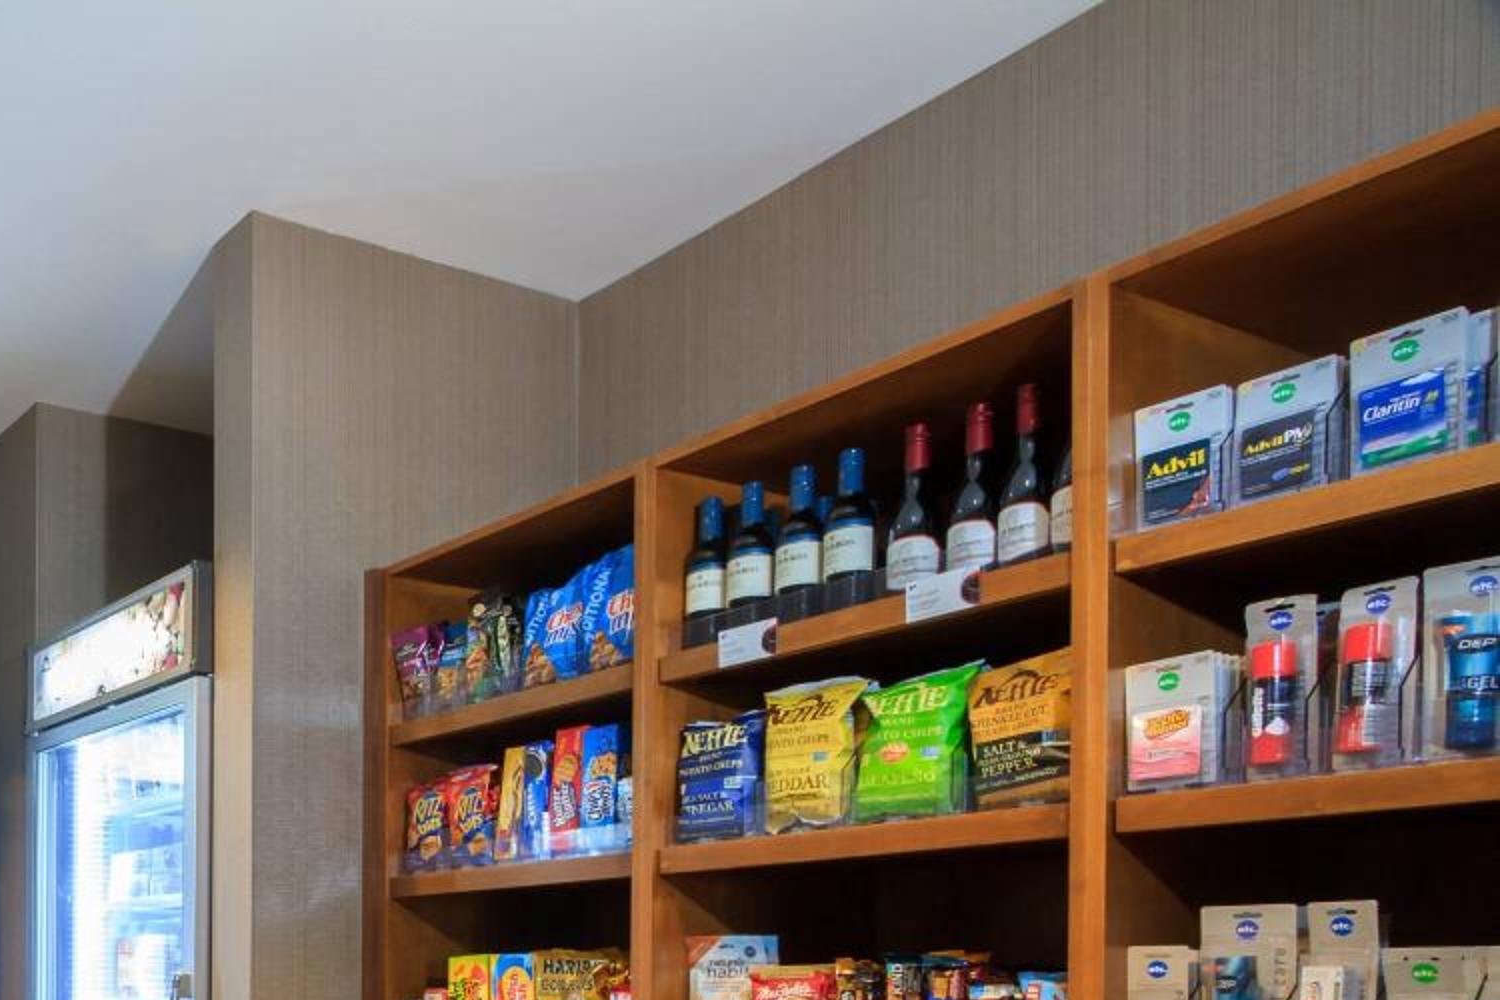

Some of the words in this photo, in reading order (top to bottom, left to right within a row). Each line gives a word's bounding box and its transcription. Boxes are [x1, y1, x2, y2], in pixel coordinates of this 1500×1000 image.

[1363, 395, 1422, 422] Claritin
[1145, 448, 1205, 479] Advil
[1457, 637, 1498, 650] DEP
[1467, 676, 1499, 690] GEL
